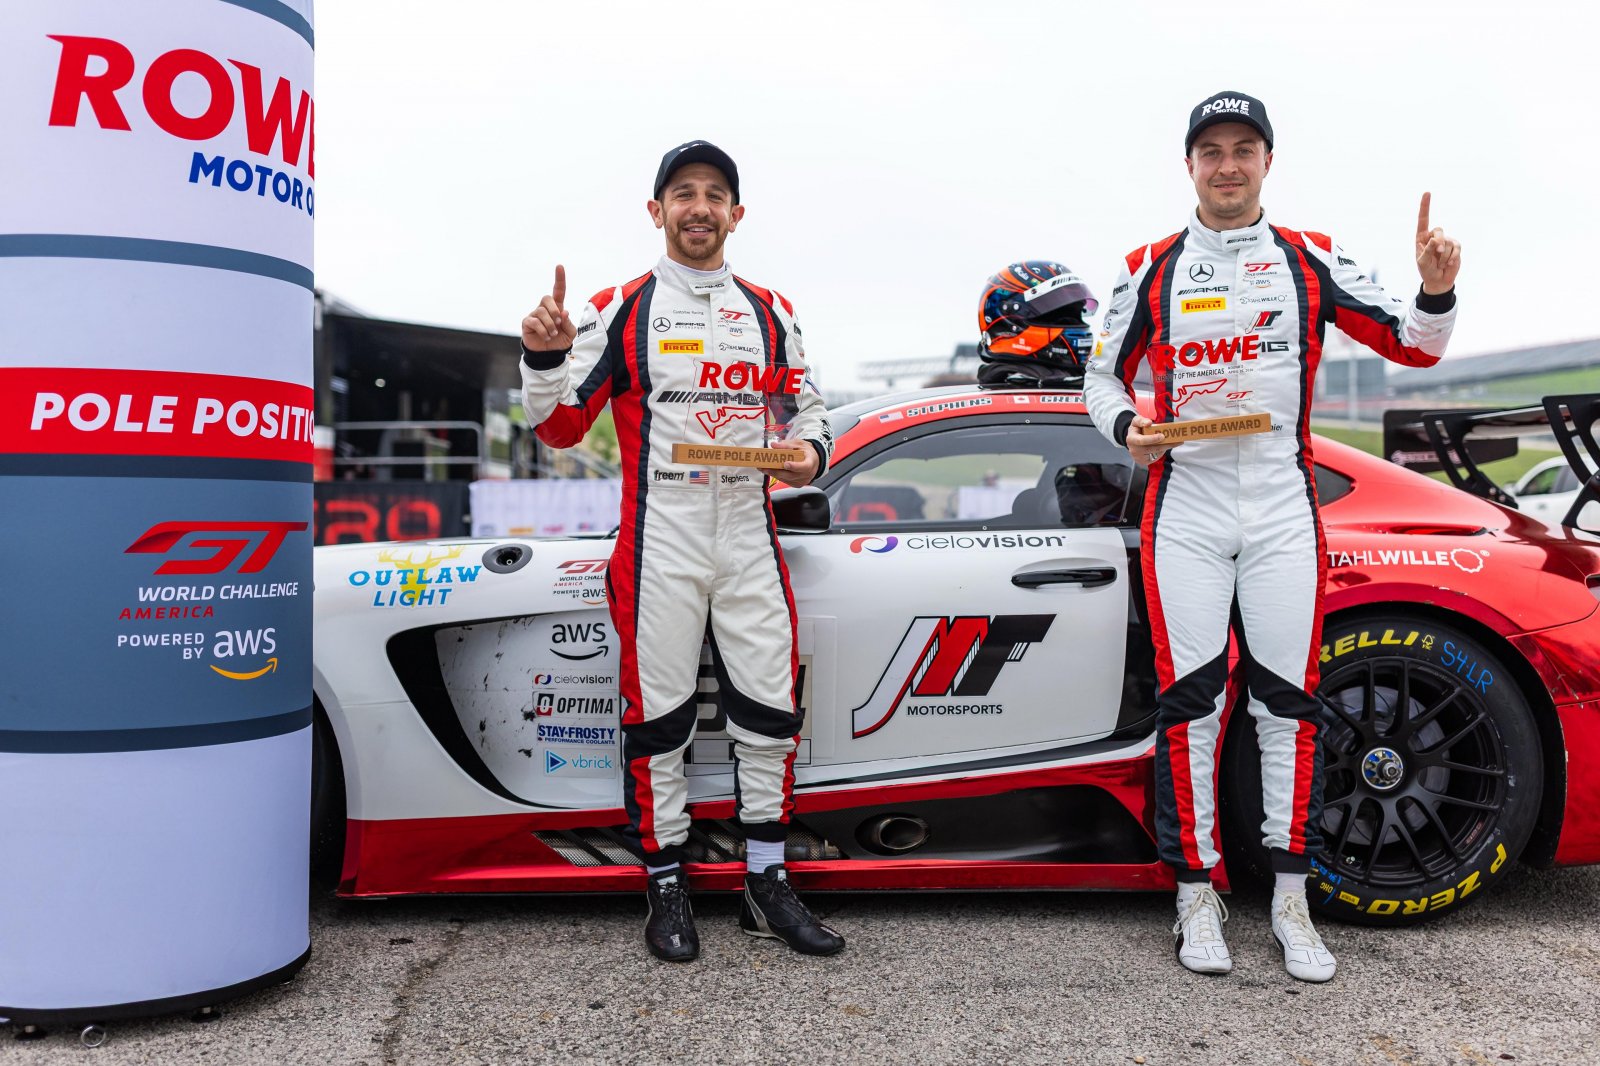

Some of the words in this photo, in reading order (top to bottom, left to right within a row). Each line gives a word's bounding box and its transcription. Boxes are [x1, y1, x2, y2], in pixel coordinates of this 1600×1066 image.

[46, 34, 314, 181] ROW
[1202, 98, 1249, 116] ROWE
[189, 152, 303, 210] MOTOR
[663, 342, 699, 351] PIRELLI
[1155, 335, 1259, 370] ROWE
[699, 361, 805, 394] ROWE
[1197, 367, 1225, 377] AMERICAS
[30, 392, 178, 432] POLE
[907, 397, 992, 417] STEPHENS
[1190, 423, 1217, 435] POLE
[1220, 419, 1261, 432] AWARD
[688, 449, 721, 460] ROWE
[724, 451, 750, 462] POLE
[754, 452, 795, 463] AWARD
[721, 474, 750, 484] Stephens
[907, 533, 1063, 549] cielovision
[1327, 550, 1450, 567] TAHLWILLE
[349, 565, 482, 586] OUTLAW
[138, 586, 214, 602] WORLD
[219, 582, 299, 599] CHALLENGE
[374, 588, 451, 607] LIGHT
[118, 605, 214, 620] AMERICA
[552, 623, 606, 643] aws
[117, 632, 205, 647] POWERED
[213, 627, 276, 658] aws
[183, 648, 204, 660] BY
[554, 675, 613, 684] cielovision
[557, 697, 613, 714] OPTIMA
[907, 705, 1003, 716] MOTORSPORTS
[571, 754, 613, 769] vbrick
[1490, 843, 1507, 874] P
[1366, 871, 1481, 915] ZERO
